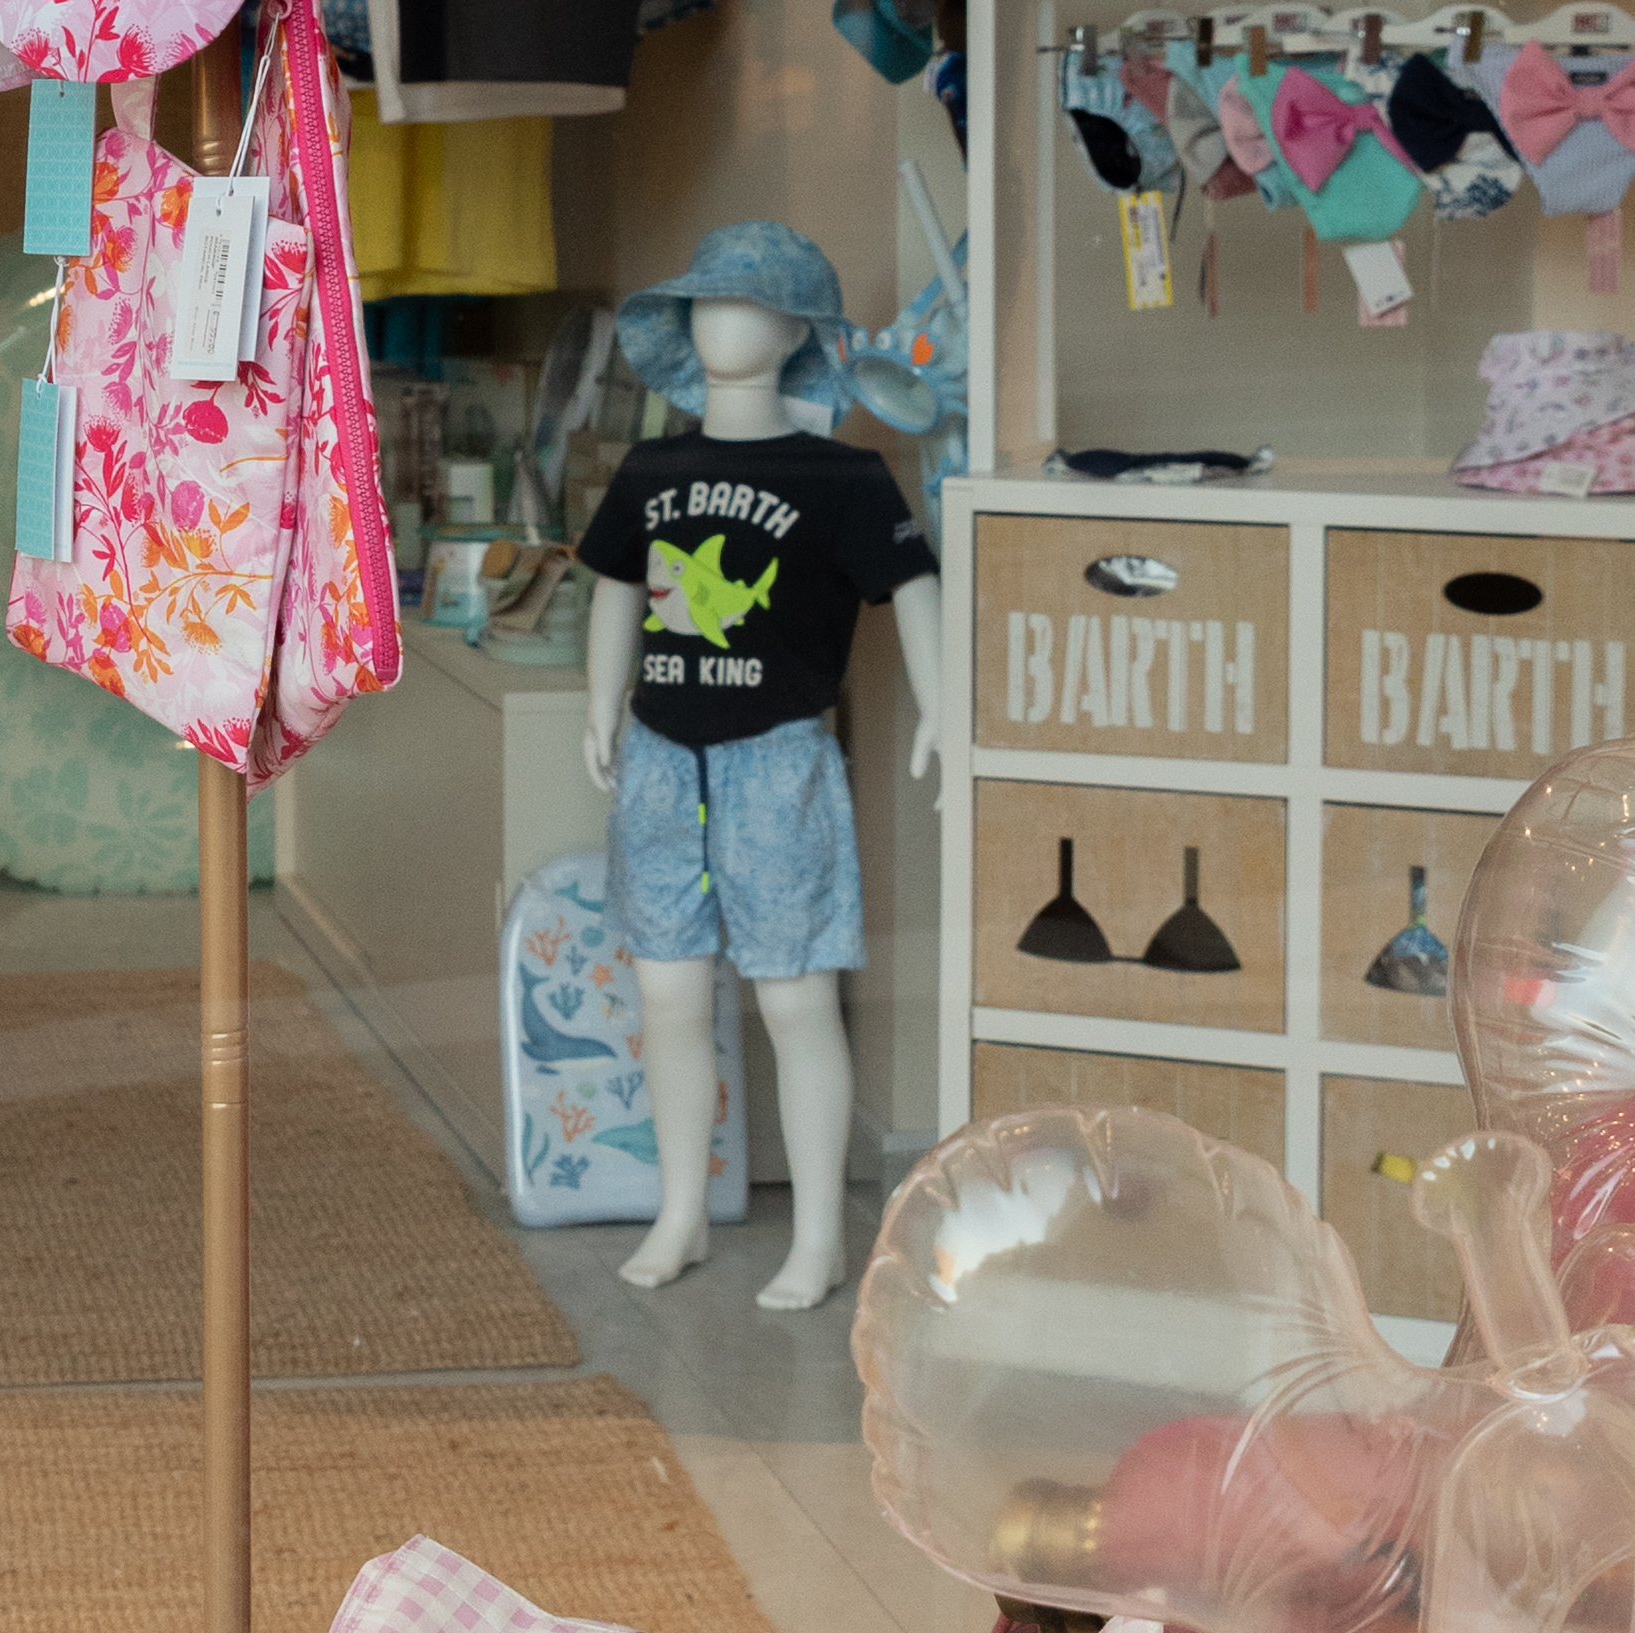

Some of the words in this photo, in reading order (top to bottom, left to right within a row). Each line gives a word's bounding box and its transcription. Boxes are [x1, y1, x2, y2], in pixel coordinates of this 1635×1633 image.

[645, 489, 679, 532] ST.
[687, 481, 800, 539] BARTH
[644, 656, 686, 685] SEA
[699, 656, 763, 687] KING
[1006, 611, 1255, 736] BARTH
[1360, 629, 1627, 757] BARTH
